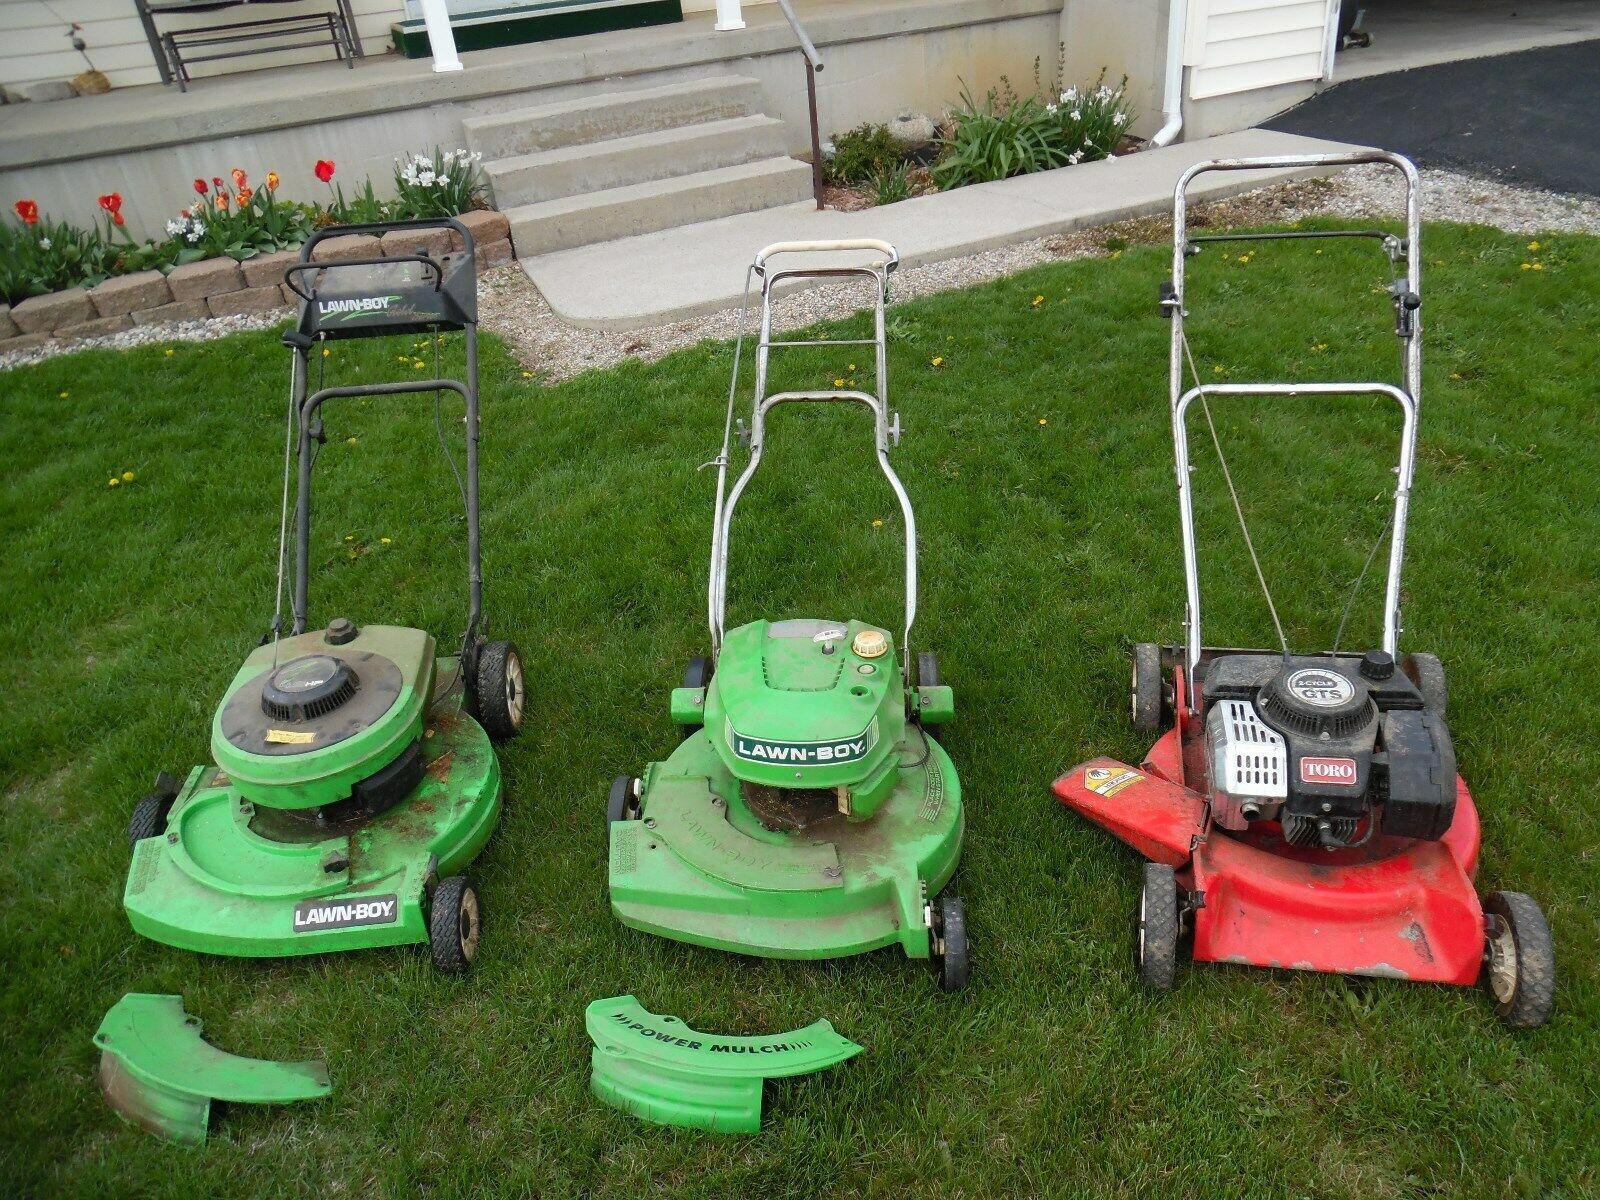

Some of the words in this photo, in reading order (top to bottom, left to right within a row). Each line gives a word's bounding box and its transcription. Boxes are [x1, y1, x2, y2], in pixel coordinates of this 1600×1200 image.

[318, 296, 388, 314] LAWN-BOY
[1302, 689, 1342, 699] GTS
[738, 740, 864, 761] LAWN-BOY
[1305, 763, 1353, 778] TORO
[294, 900, 395, 926] LAWN-BOY
[628, 1022, 703, 1051] POWER
[709, 1043, 789, 1054] MULCH
